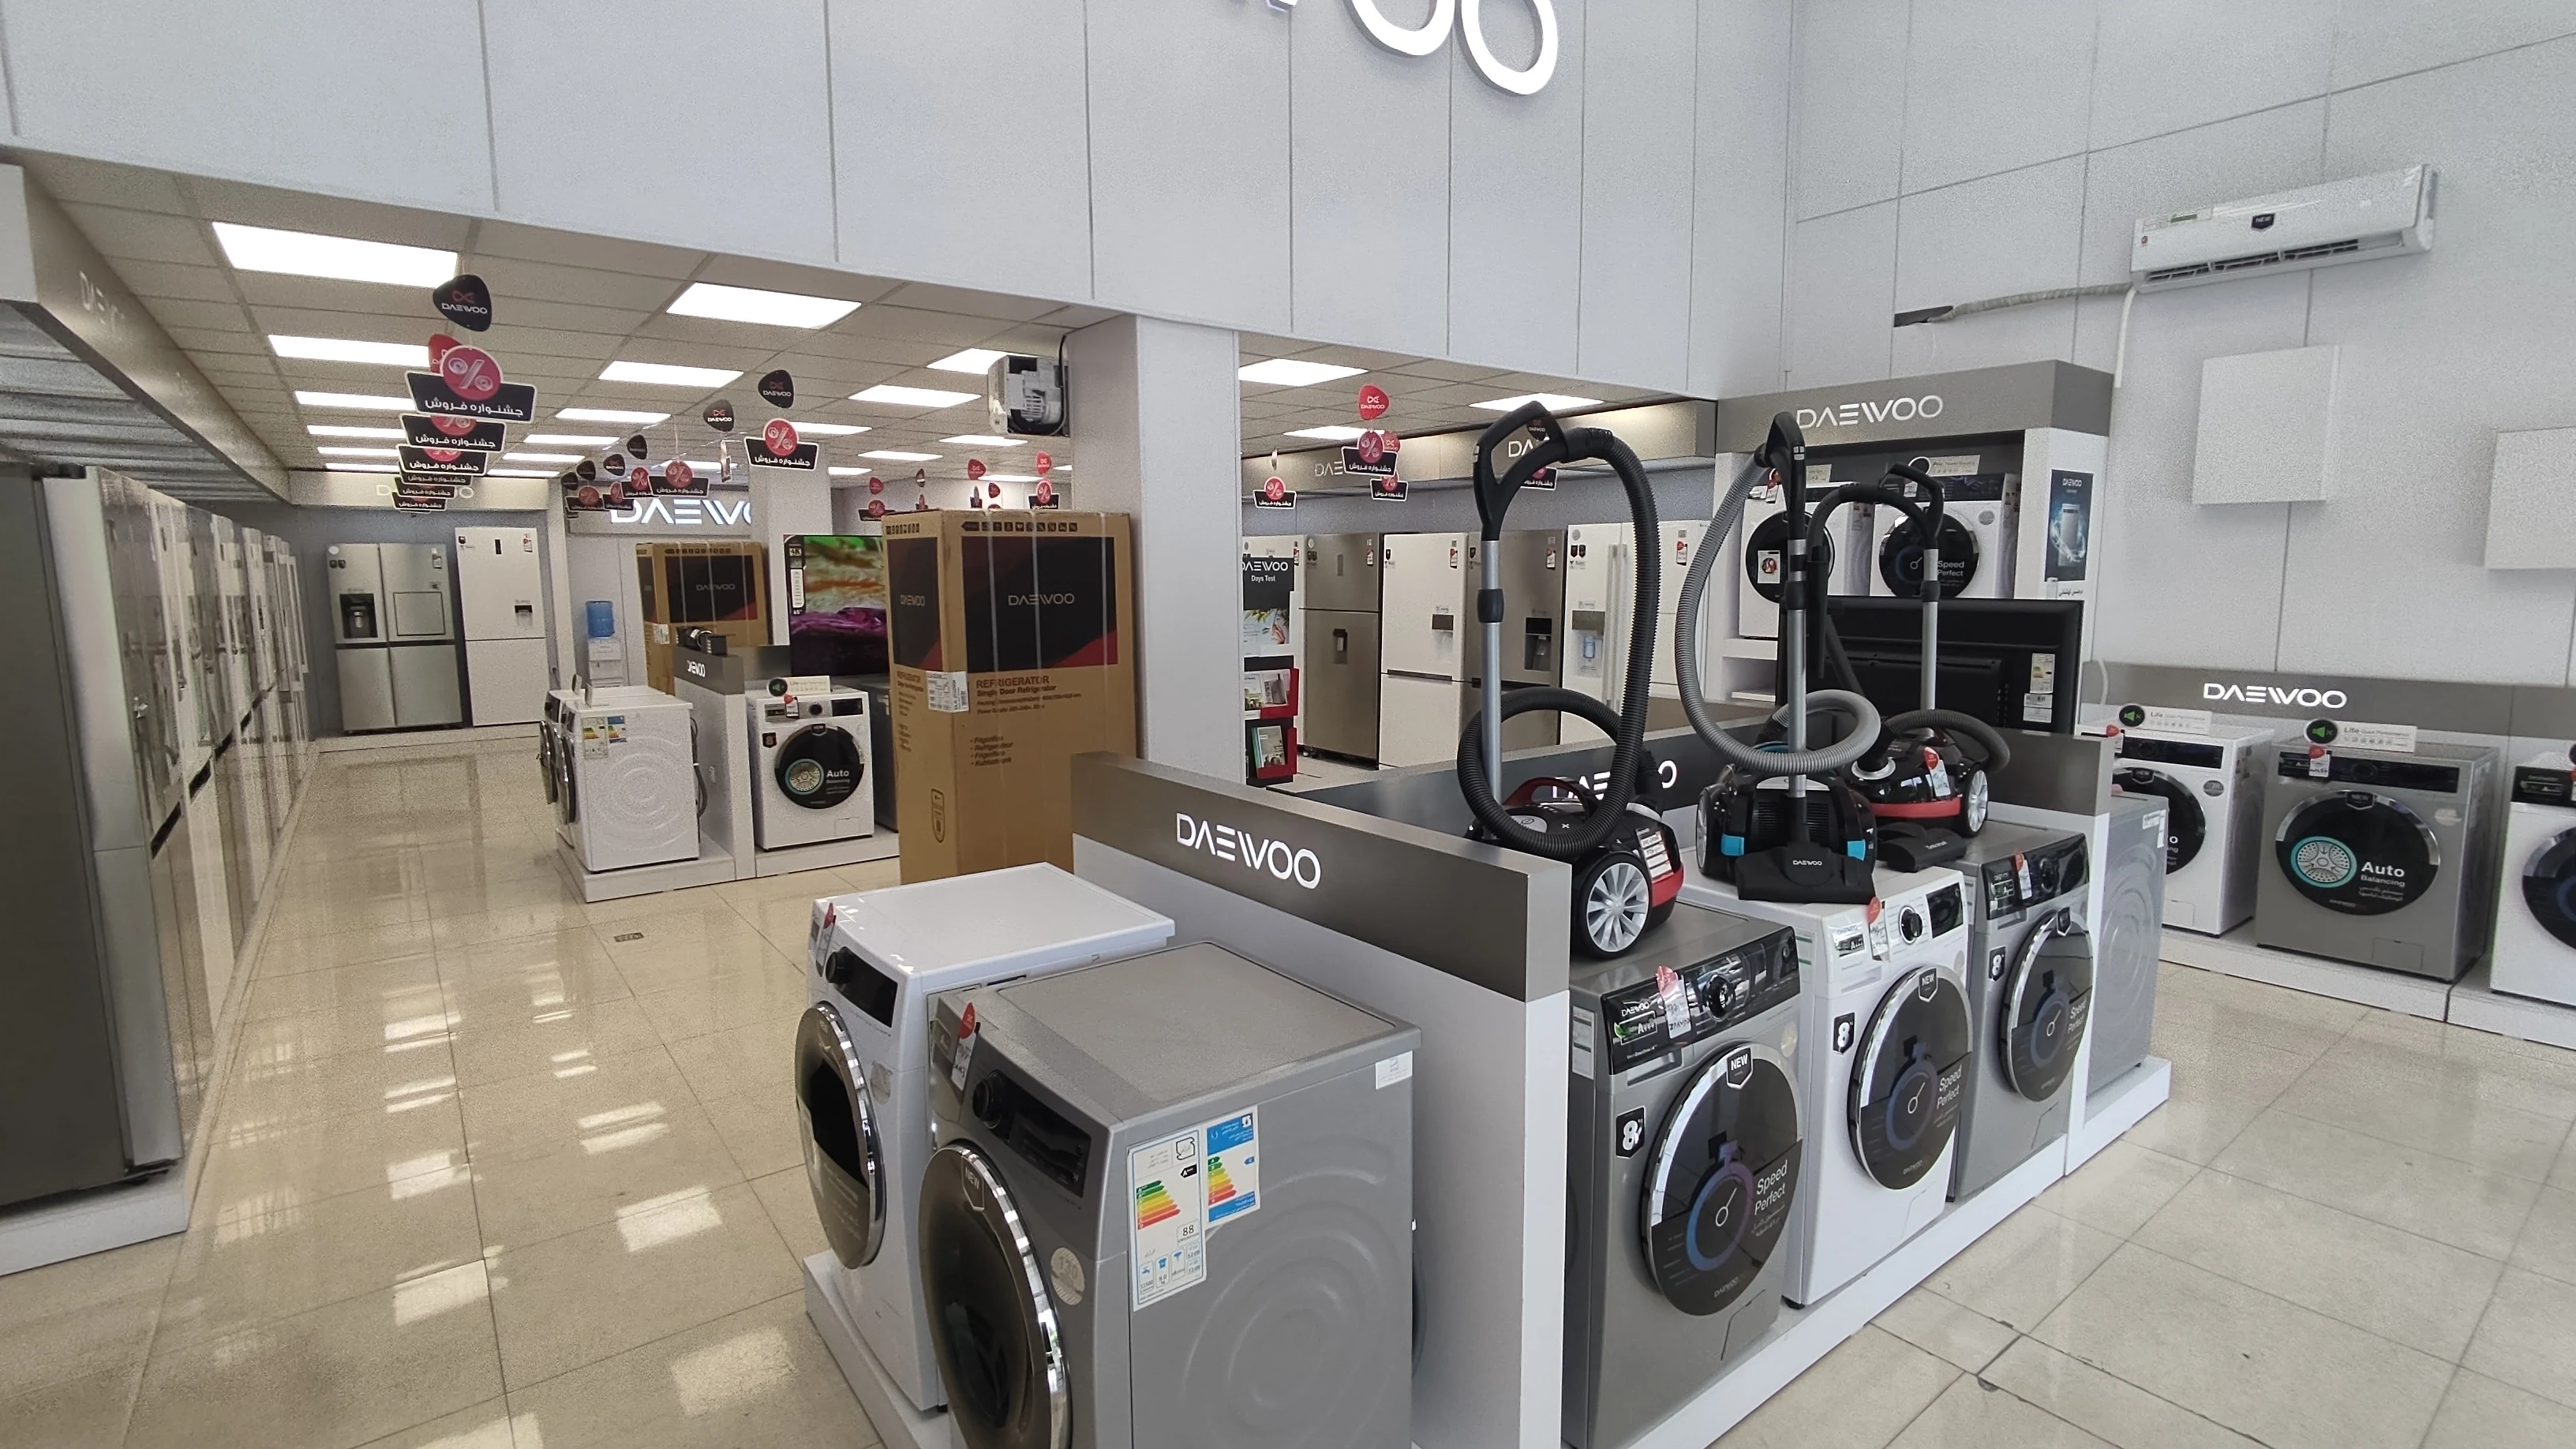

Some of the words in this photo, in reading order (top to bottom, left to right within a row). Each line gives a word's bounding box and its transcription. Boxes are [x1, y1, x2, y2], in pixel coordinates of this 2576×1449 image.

[441, 302, 488, 314] DAEWOO
[425, 397, 467, 410] فروش
[470, 403, 523, 416] جشنواره
[1796, 395, 1943, 429] DAEWOO
[415, 433, 450, 444] فروش
[451, 438, 496, 448] جشنواره
[409, 460, 440, 469] فروش
[754, 455, 778, 463] فروش
[779, 458, 811, 466] جشنواره
[440, 463, 479, 472] جشنواره
[1368, 464, 1391, 473] جشنواره
[610, 499, 751, 525] DAEW
[1938, 560, 1964, 571] Speed
[900, 594, 925, 607] DAEWOO
[1008, 593, 1075, 605] DAEWOO
[976, 675, 1050, 689] REFRIGERATOR
[2203, 683, 2348, 709] DAEWOO
[1176, 812, 1321, 889] DAEWOO
[2361, 861, 2405, 878] Auto
[2361, 874, 2406, 888] Balancing
[1992, 954, 2002, 976] 8
[1922, 972, 1935, 987] NEW
[1621, 1001, 1650, 1017] DAEWOO
[1837, 1022, 1851, 1047] 8
[1730, 1053, 1749, 1071] NEW
[1939, 1064, 1963, 1092] Speed
[1936, 1084, 1960, 1110] Perfect
[1623, 1120, 1638, 1151] 8
[964, 1166, 979, 1191] NEW
[1756, 1159, 1788, 1196] Speed
[1754, 1182, 1786, 1216] Perfect
[1182, 1224, 1194, 1237] 88
